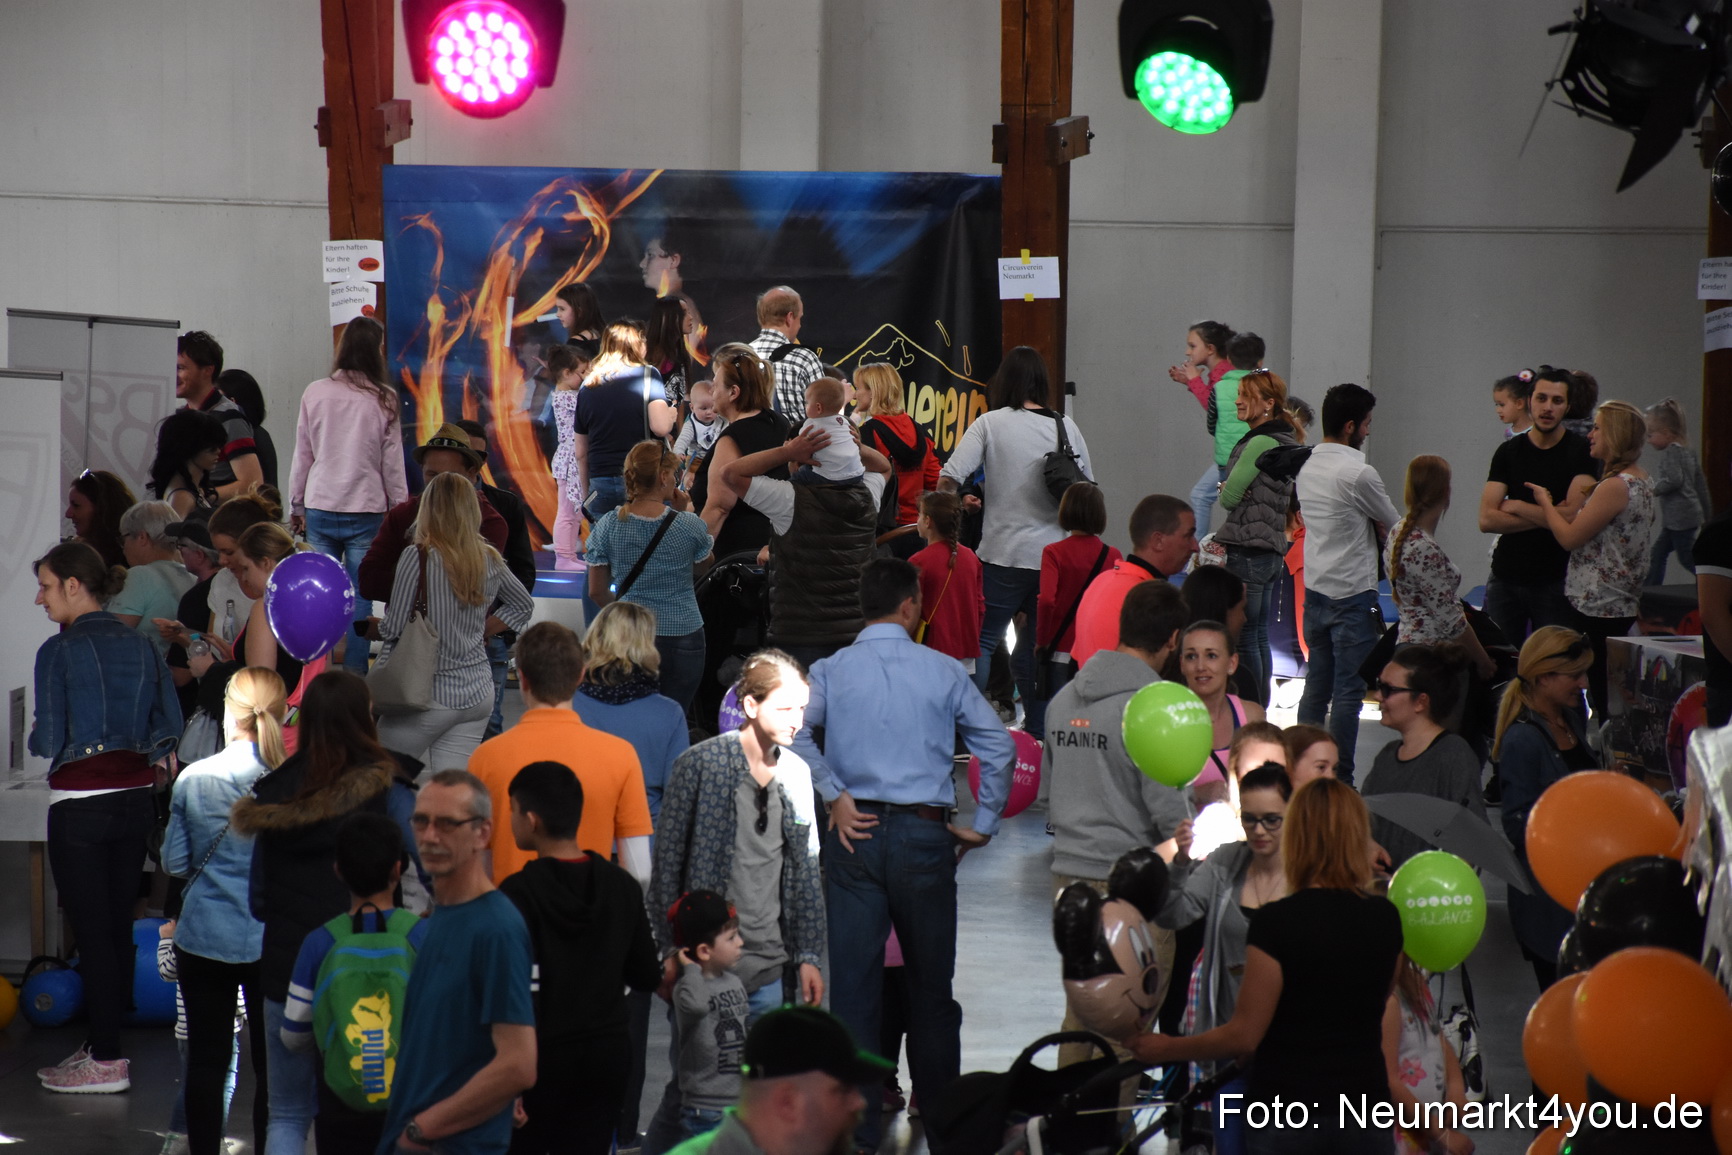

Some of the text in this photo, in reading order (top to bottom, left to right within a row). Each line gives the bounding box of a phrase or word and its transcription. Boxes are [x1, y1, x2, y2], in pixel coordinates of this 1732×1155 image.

[346, 244, 368, 252] haften
[331, 287, 345, 296] Bitte
[331, 297, 365, 307] ausziehen!
[361, 1029, 386, 1094] PUMA
